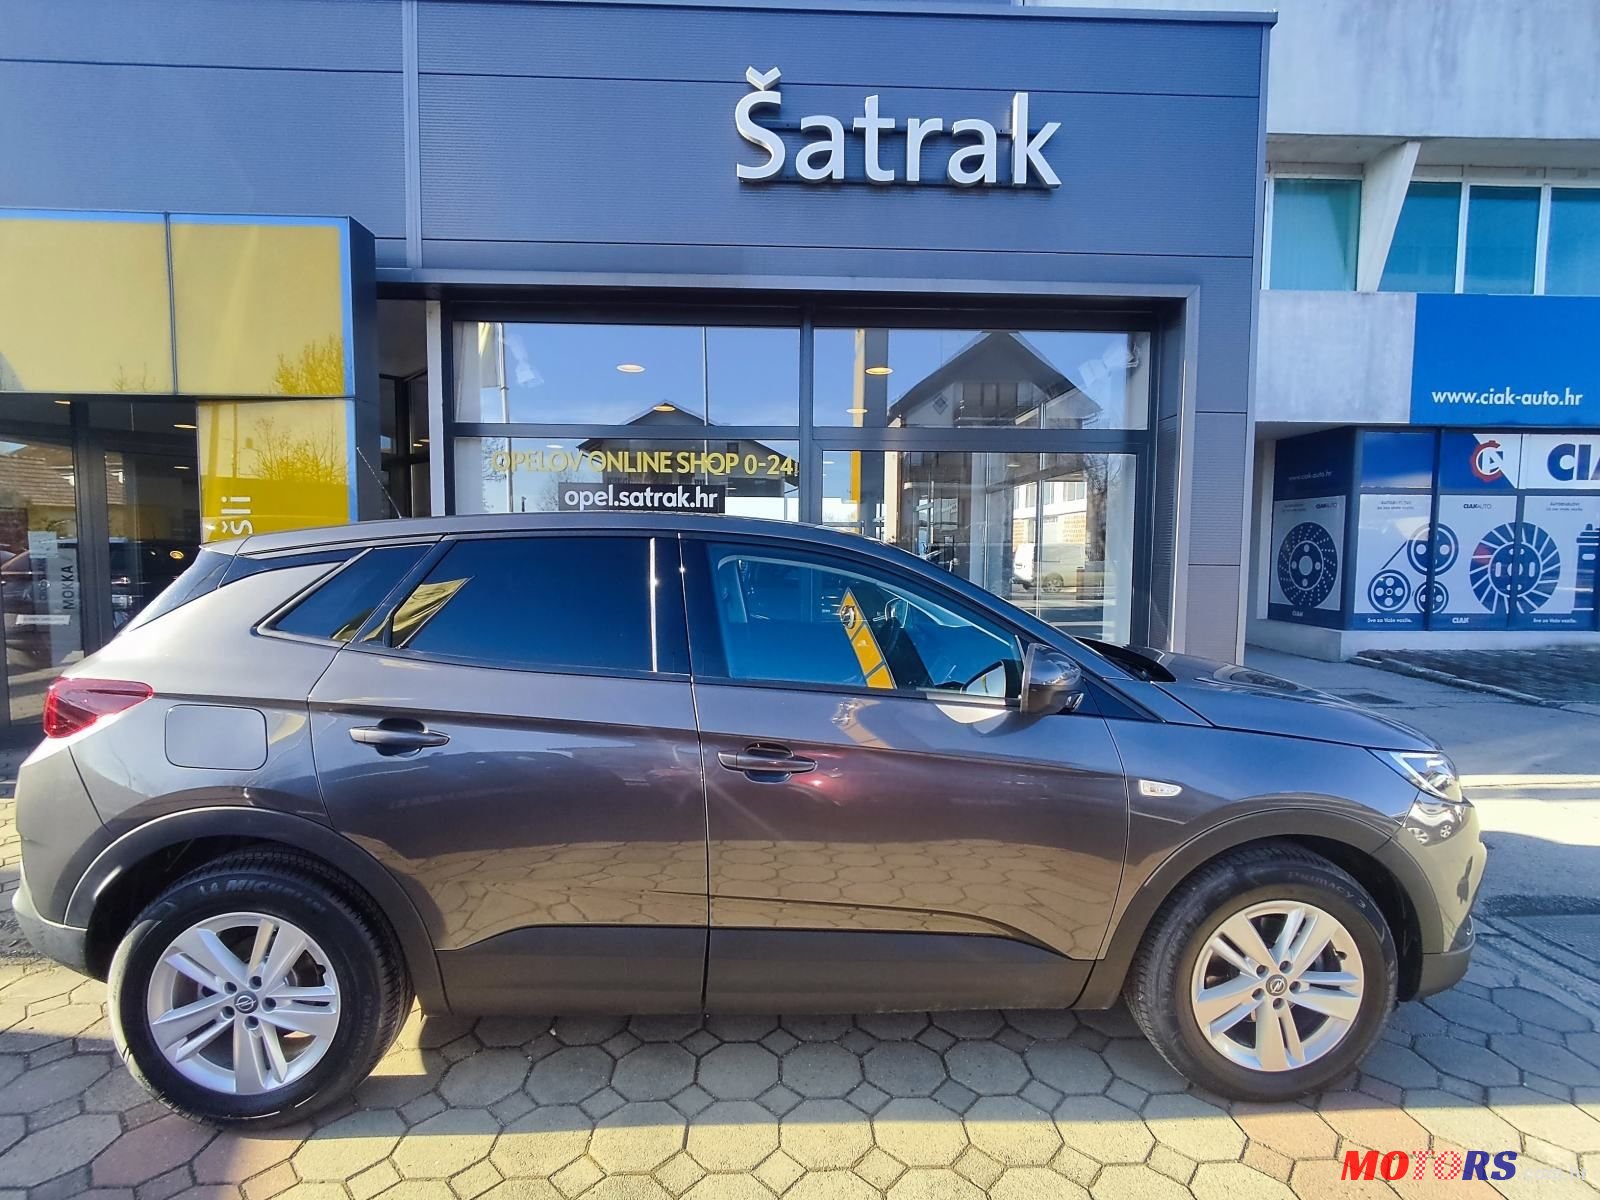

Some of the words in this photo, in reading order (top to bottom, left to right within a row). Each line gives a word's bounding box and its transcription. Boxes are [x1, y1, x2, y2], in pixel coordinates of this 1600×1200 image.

[735, 66, 1062, 188] Šatrak
[1431, 387, 1583, 406] www.ciak-auto.hr
[491, 451, 583, 473] OPELOV
[588, 451, 672, 474] ONLINE
[676, 451, 740, 476] SHOP
[1547, 443, 1600, 481] CI
[564, 484, 719, 511] opel.satrak.hr
[61, 565, 75, 610] MOKKA
